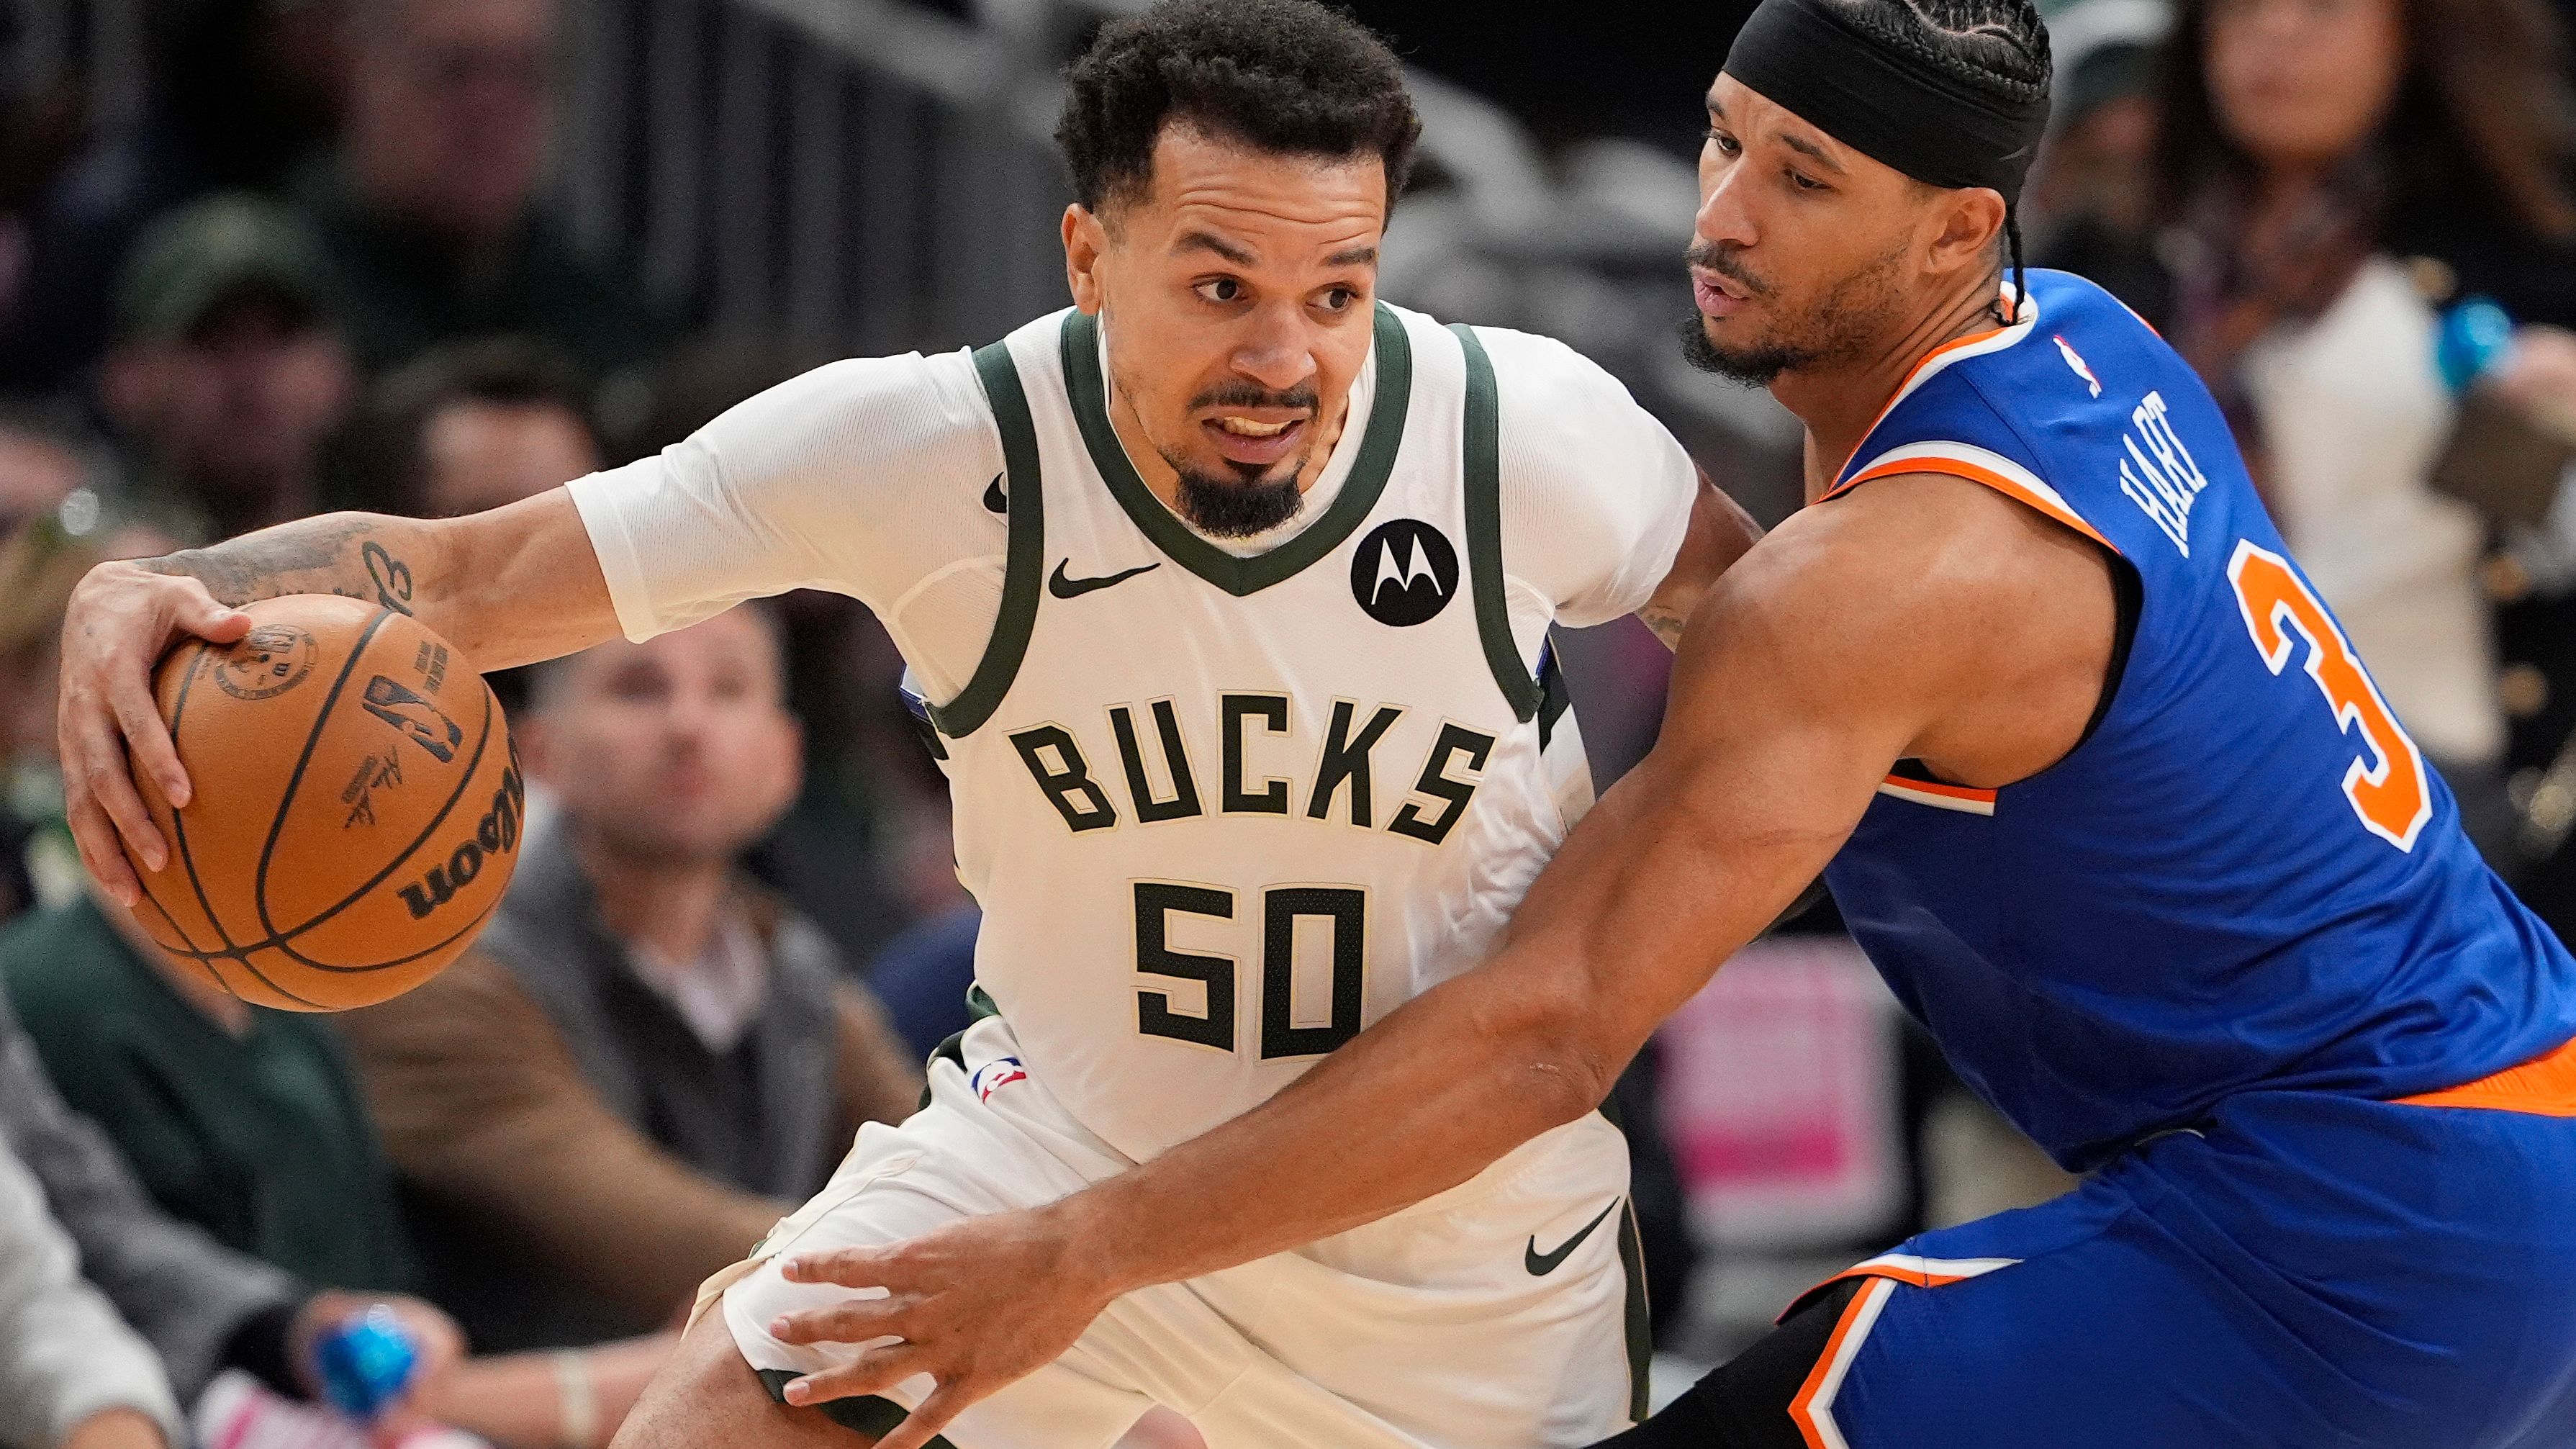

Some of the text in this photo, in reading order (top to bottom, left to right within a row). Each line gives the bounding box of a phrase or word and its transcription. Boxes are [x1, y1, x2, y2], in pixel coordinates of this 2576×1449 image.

[2119, 389, 2208, 559] HART
[1005, 691, 1499, 846] BUCKS
[2226, 538, 2433, 854] 3
[1128, 879, 1370, 1064] 50
